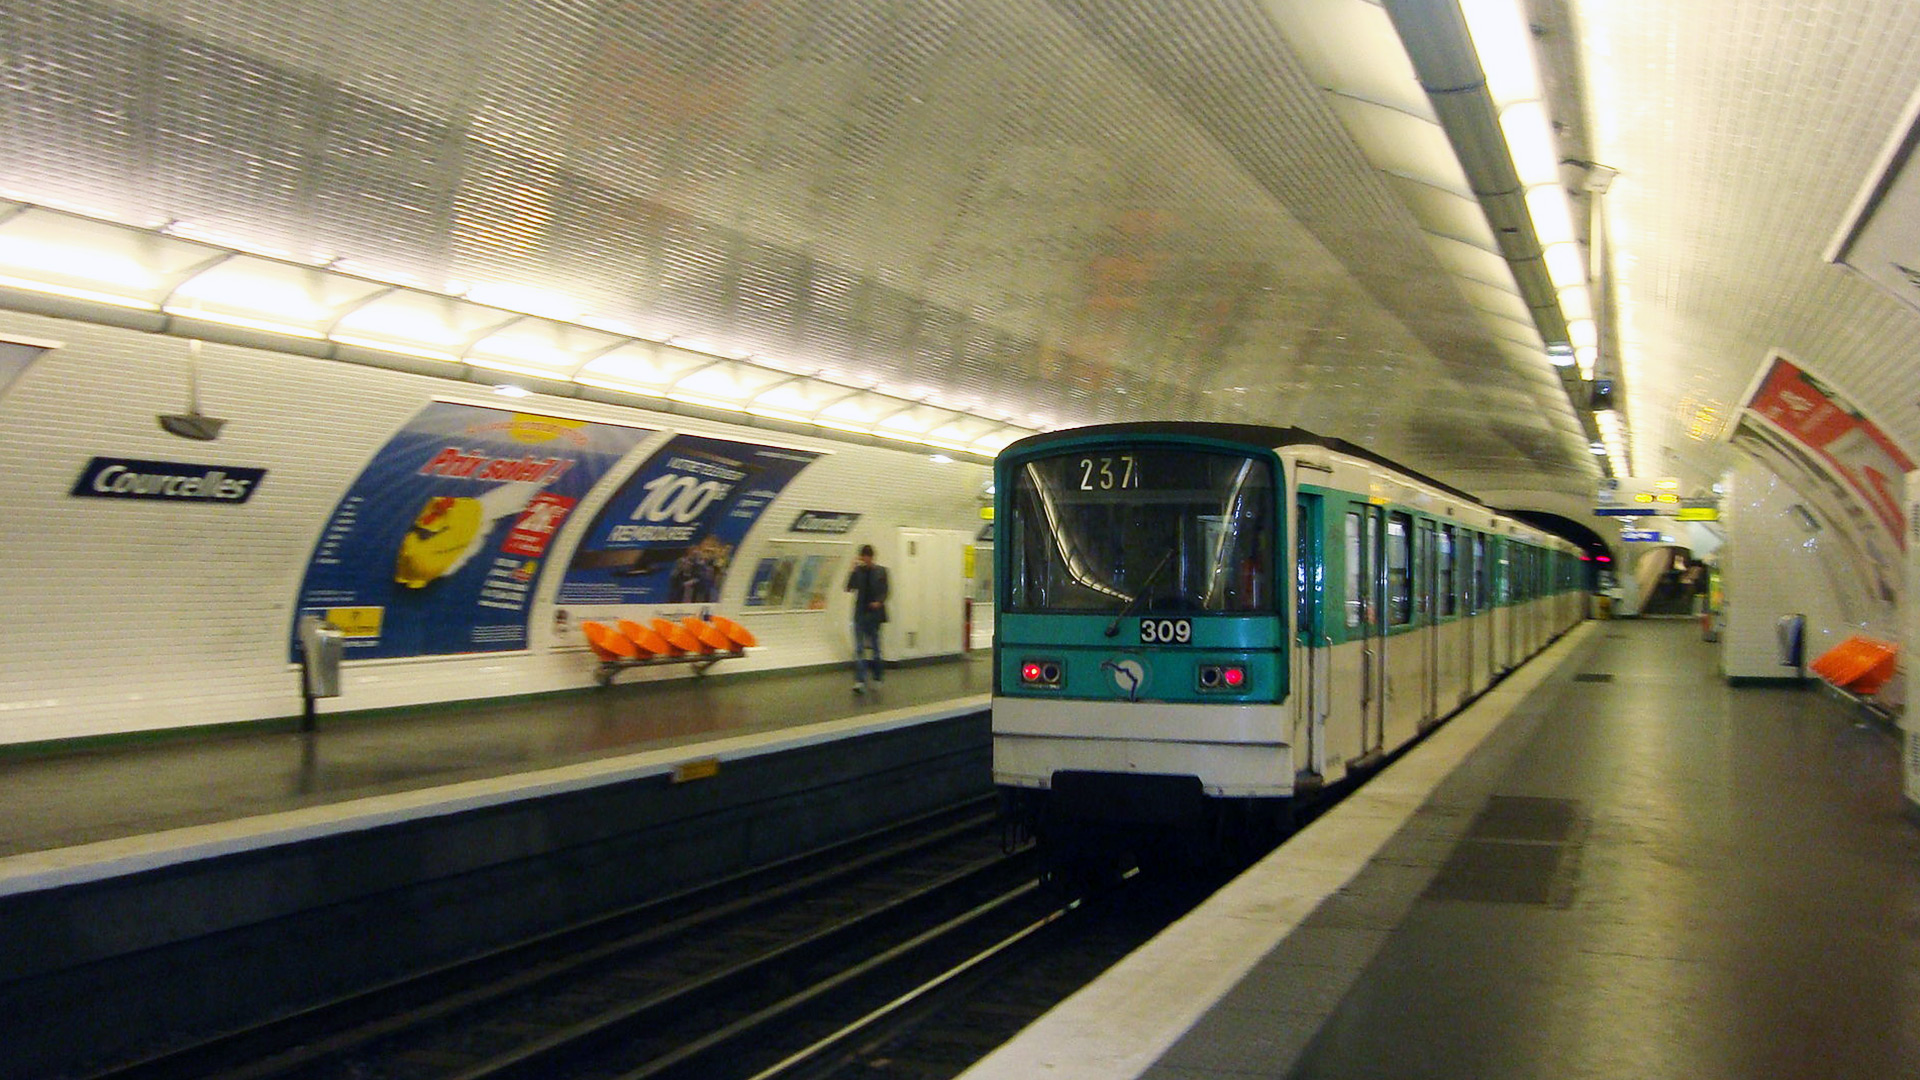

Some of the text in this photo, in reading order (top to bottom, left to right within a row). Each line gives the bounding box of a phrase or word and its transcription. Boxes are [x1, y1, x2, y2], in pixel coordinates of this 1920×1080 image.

[93, 465, 251, 498] Courcelles
[1080, 456, 1133, 491] 237
[1141, 620, 1191, 642] 309
